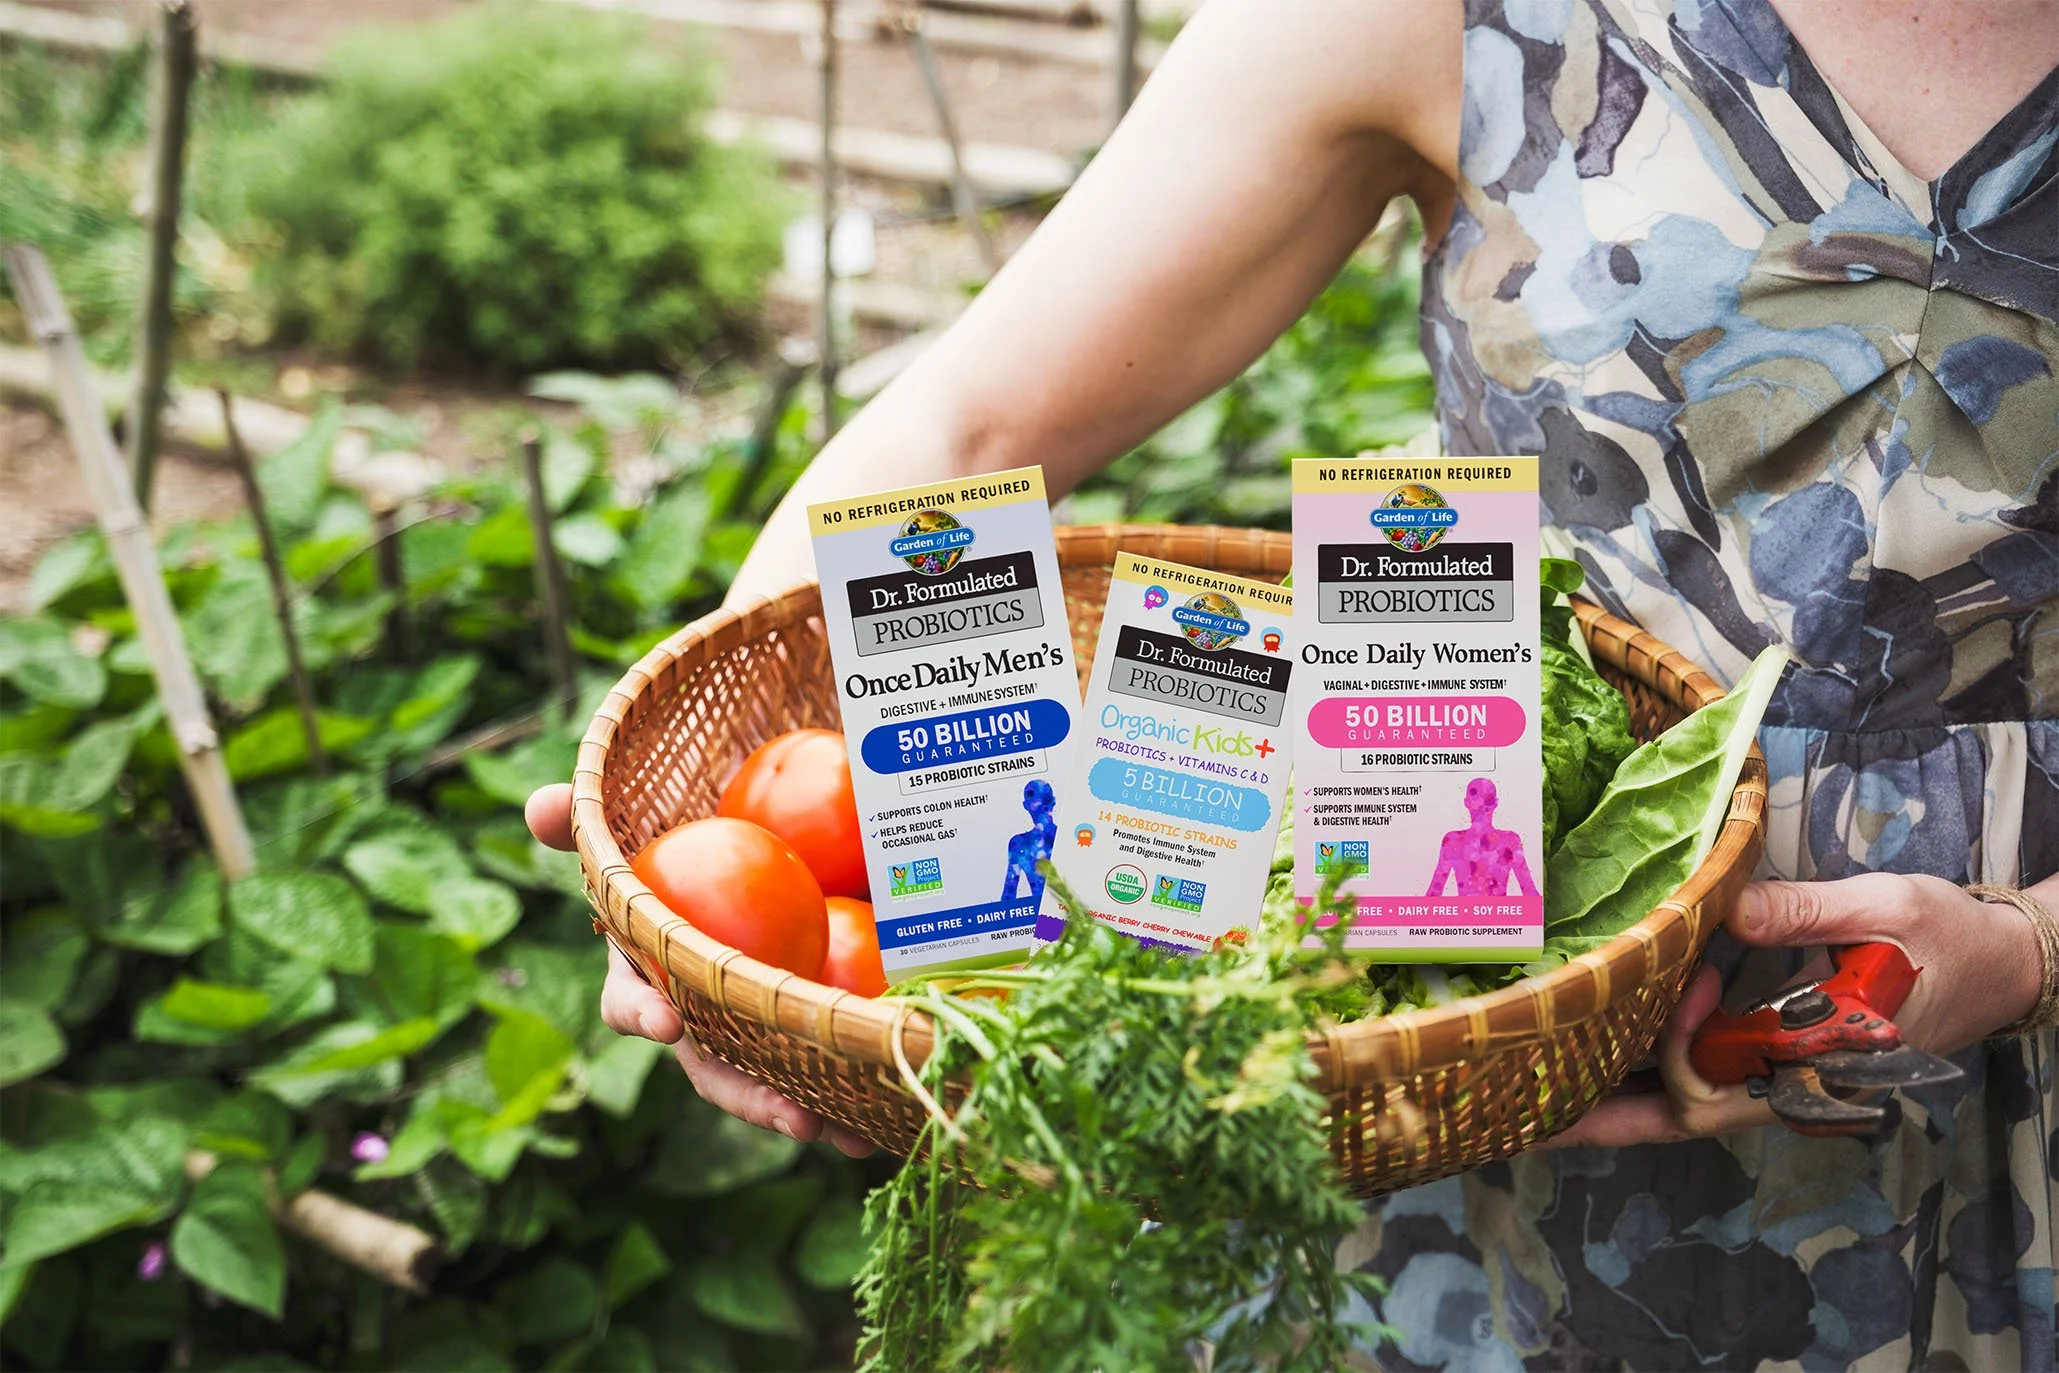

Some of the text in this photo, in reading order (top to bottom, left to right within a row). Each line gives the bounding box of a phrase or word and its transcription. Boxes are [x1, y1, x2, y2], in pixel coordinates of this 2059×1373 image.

[1320, 467, 1512, 481] NO REFRIGERATION REQUIRED
[823, 479, 1031, 524] NO REFRIGERATION REQUIRED
[1374, 511, 1453, 525] Garden of Life
[894, 531, 970, 552] Garden of Life
[1340, 555, 1493, 577] Dr. Formulated
[870, 566, 1018, 609] Dr. Formulated
[1132, 562, 1293, 605] NO REFRIGERATION REQUIR
[1338, 589, 1495, 613] PROBIOTICS
[873, 599, 1025, 645] PROBIOTICS
[1176, 610, 1245, 632] Garden of Life
[1136, 640, 1272, 685] Dr. Formulated
[1301, 642, 1532, 670] Once Daily Women's
[845, 642, 1064, 699] Once Daily Men's
[1128, 667, 1267, 715] PROBIOTICS
[880, 700, 937, 719] DIGESTIVE
[949, 691, 993, 708] IMMUNE
[1345, 704, 1487, 728] 50 BILLION
[898, 710, 1032, 752] 50 BILLION
[1101, 704, 1190, 745] Organic
[1348, 729, 1486, 740] GUARANTEED
[902, 732, 1034, 764] GUARANTEED
[1361, 753, 1473, 765] 16 PROBIOTIC STRAINS
[1096, 737, 1166, 762] PROBIOTICS
[1178, 755, 1238, 777] VITAMINS
[1240, 769, 1249, 779] C
[1250, 771, 1258, 782] &
[1260, 773, 1269, 784] D
[909, 756, 1035, 788] 15 PROBIOTIC STRAINS
[1123, 768, 1243, 811] 5 BILLION
[1313, 787, 1352, 796] SUPPORTS
[1353, 786, 1390, 796] WOMEN'S
[877, 806, 922, 822] SUPPORTS
[924, 800, 952, 814] COLON
[1122, 789, 1240, 822] GUARANTEED
[1313, 804, 1417, 814] SUPPORTS IMMUNE SYSTEM
[880, 819, 943, 837] HELPS REDUCE
[1098, 810, 1237, 850] 14 PROBIOTIC STRAINS
[1313, 817, 1320, 826] &
[1322, 816, 1360, 826] DIGESTIVE
[882, 833, 936, 849] OCCASIONAL
[1113, 828, 1216, 858] Promotes Immune System
[1119, 843, 1134, 854] and
[1136, 847, 1173, 863] Digestive
[916, 860, 937, 869] NON
[916, 867, 938, 876] GMO
[893, 882, 941, 895] VERIFIED
[1110, 883, 1141, 896] ORGANIC
[1115, 872, 1139, 885] USDA
[1182, 881, 1203, 891] NON
[1154, 896, 1199, 911] VERIFIED
[1181, 888, 1203, 898] GMO
[897, 906, 1035, 937] GLUTEN FREE DAIRY FREE
[1357, 905, 1523, 916] FREE DAIRY FREE SOY FREE
[991, 926, 1036, 941] RAW PROBIO
[1088, 909, 1212, 943] RGANIC BERRY CHERRY CHEWABLE
[1409, 927, 1523, 936] RAW PROBIOTIC SUPPLEMENT
[910, 943, 947, 954] VEGETARIAN
[948, 937, 980, 947] CAPSULES
